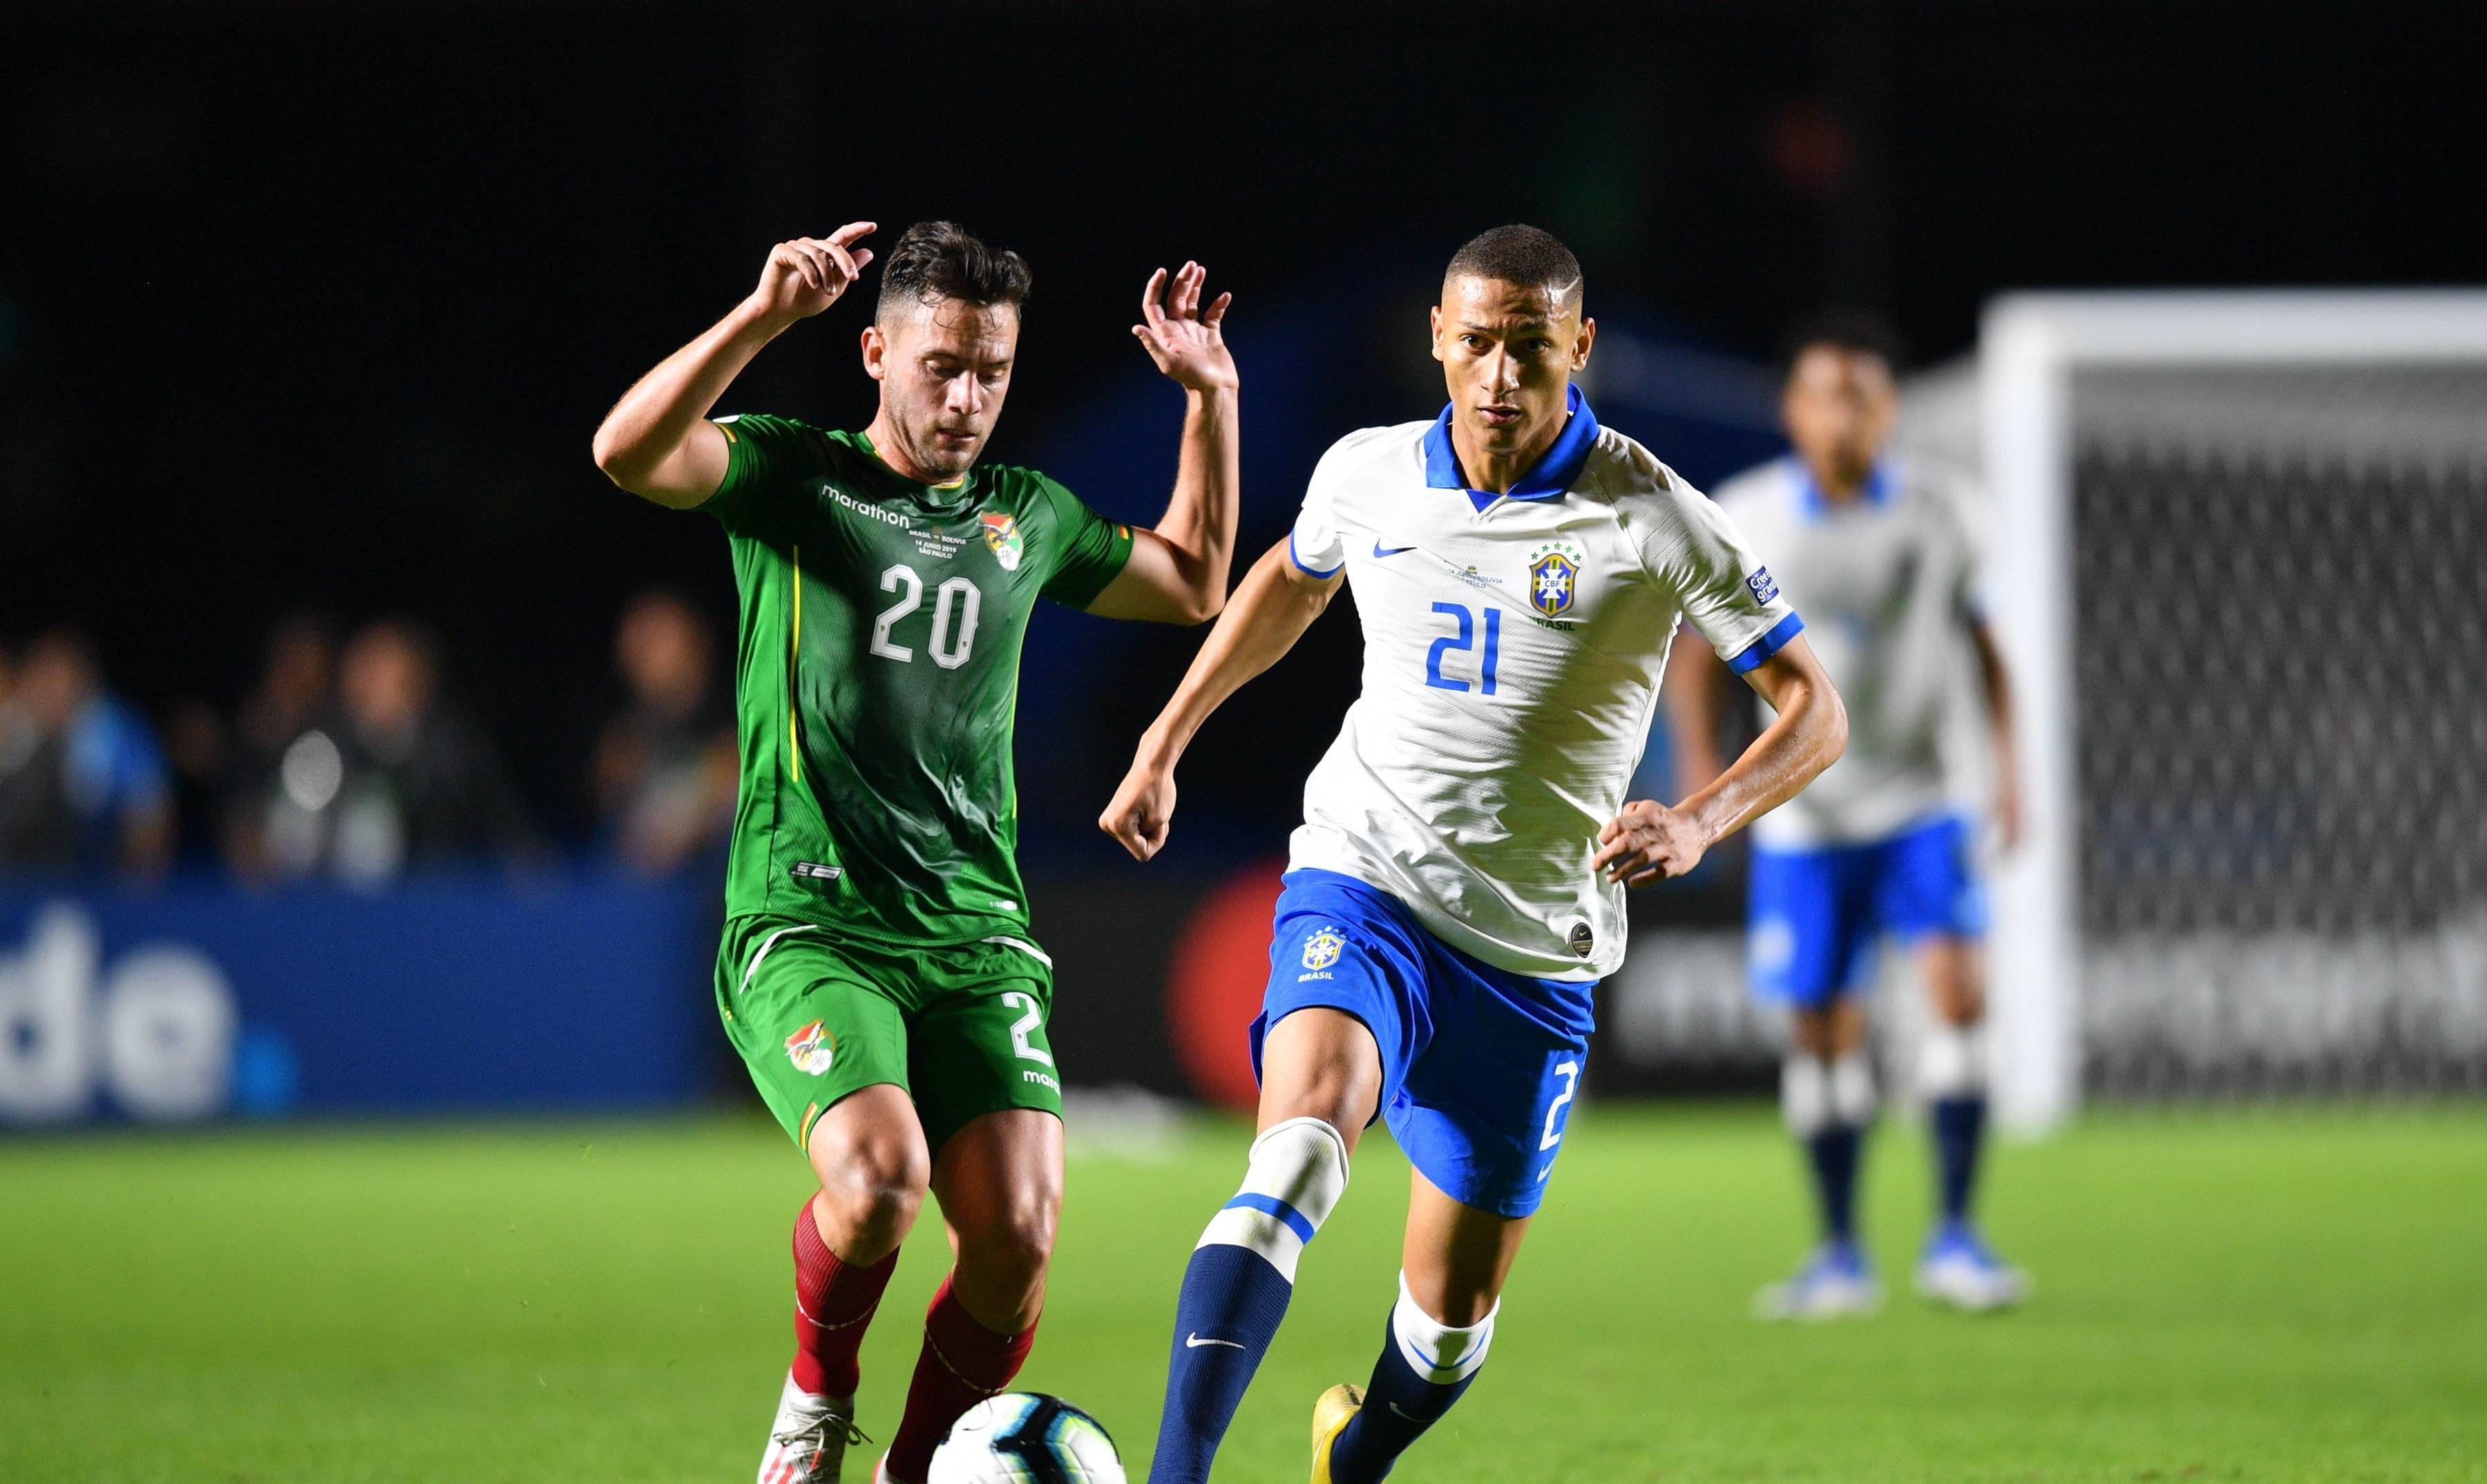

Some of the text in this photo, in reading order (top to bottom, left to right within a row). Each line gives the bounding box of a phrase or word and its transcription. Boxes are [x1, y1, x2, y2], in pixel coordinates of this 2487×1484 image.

[822, 484, 910, 529] marathon
[908, 530, 931, 539] BRASIL
[942, 535, 966, 545] BOLIVIA
[923, 542, 942, 551] JUNIO
[942, 545, 957, 553] 2019
[931, 550, 953, 559] PAULO
[1544, 580, 1561, 588] CBF
[869, 563, 981, 670] 20
[1425, 600, 1502, 696] 21
[1297, 971, 1335, 982] BRASIL
